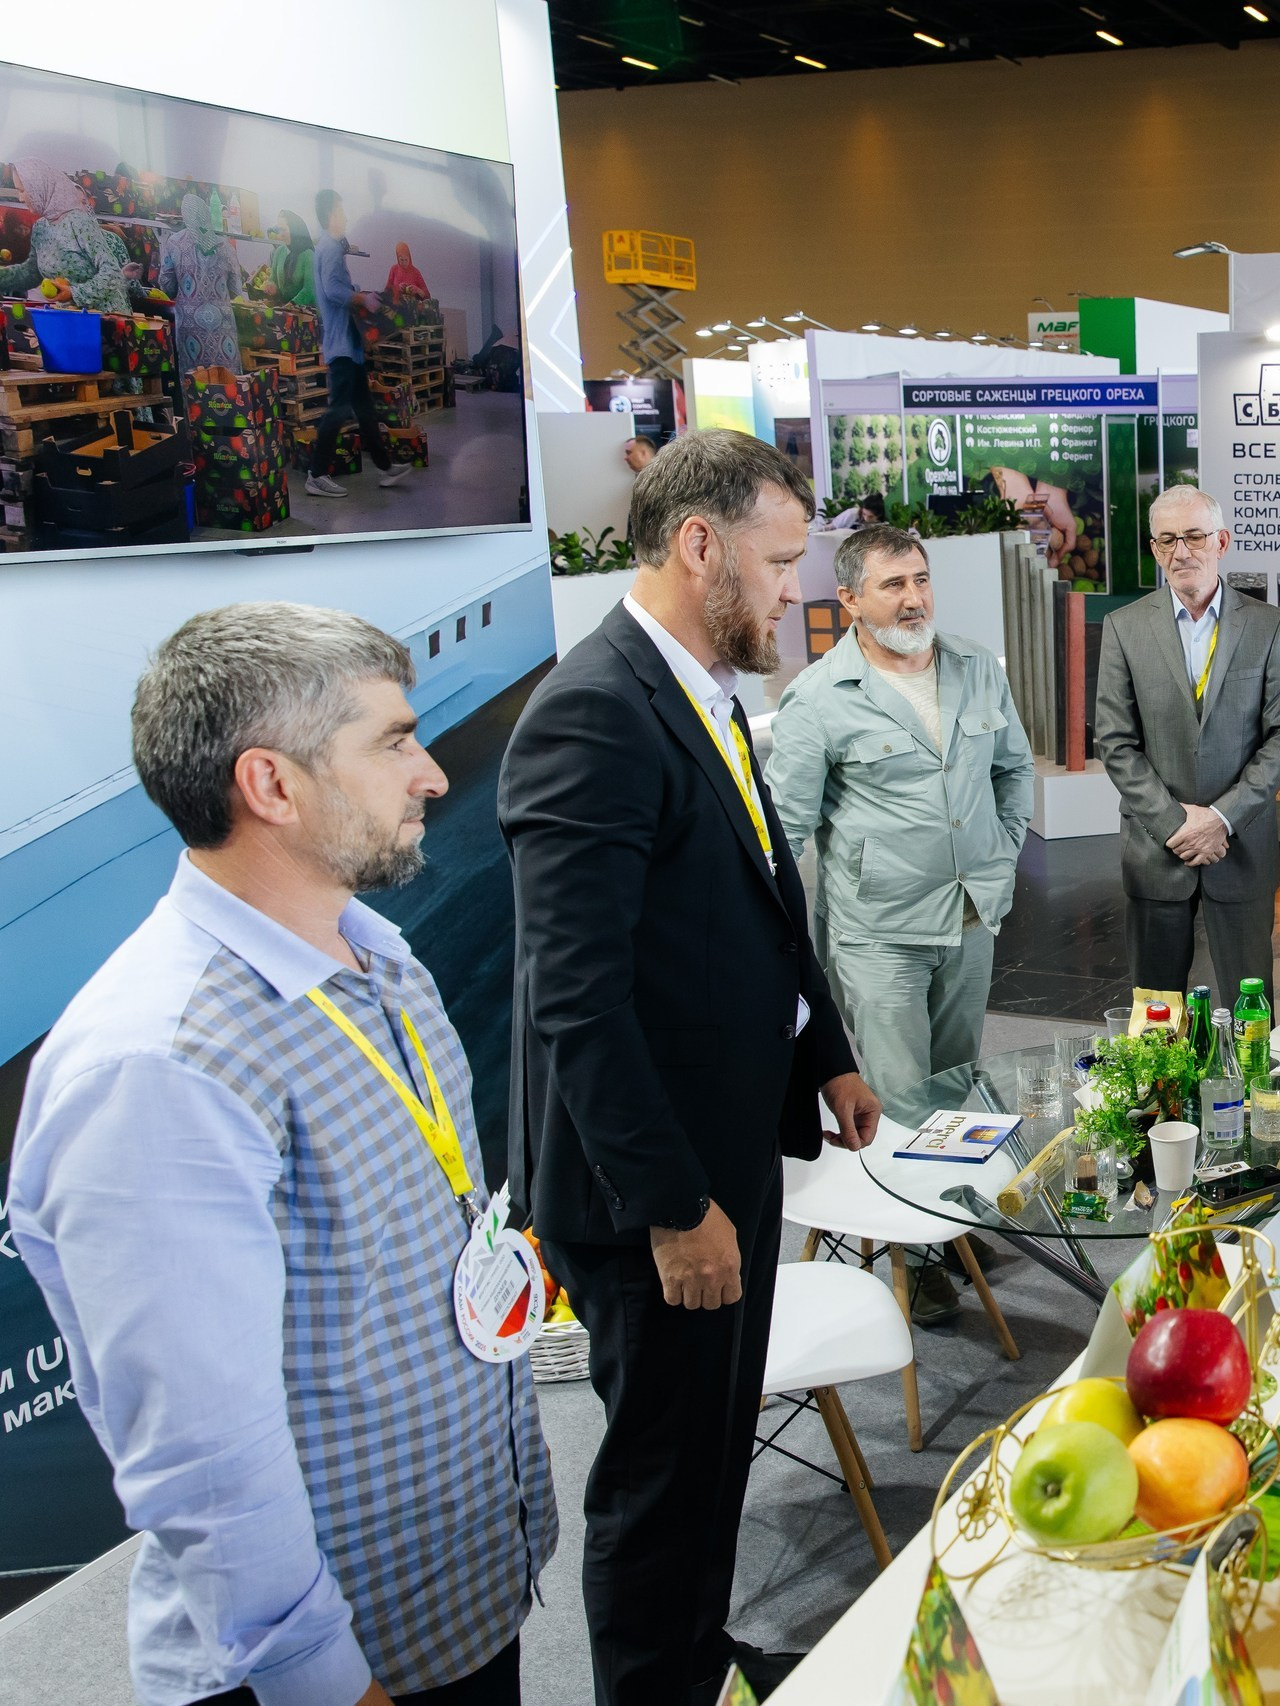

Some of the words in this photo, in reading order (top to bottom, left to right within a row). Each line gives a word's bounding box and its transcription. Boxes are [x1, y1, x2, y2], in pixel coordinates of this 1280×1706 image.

[912, 390, 972, 403] СОРТОВЫЕ
[976, 389, 1036, 403] САЖЕНЦЫ
[1041, 388, 1101, 403] ГРЕЦКОГО
[1106, 388, 1145, 401] ОРЕХА
[1232, 443, 1277, 459] ВСЕ
[925, 1116, 967, 1149] merci
